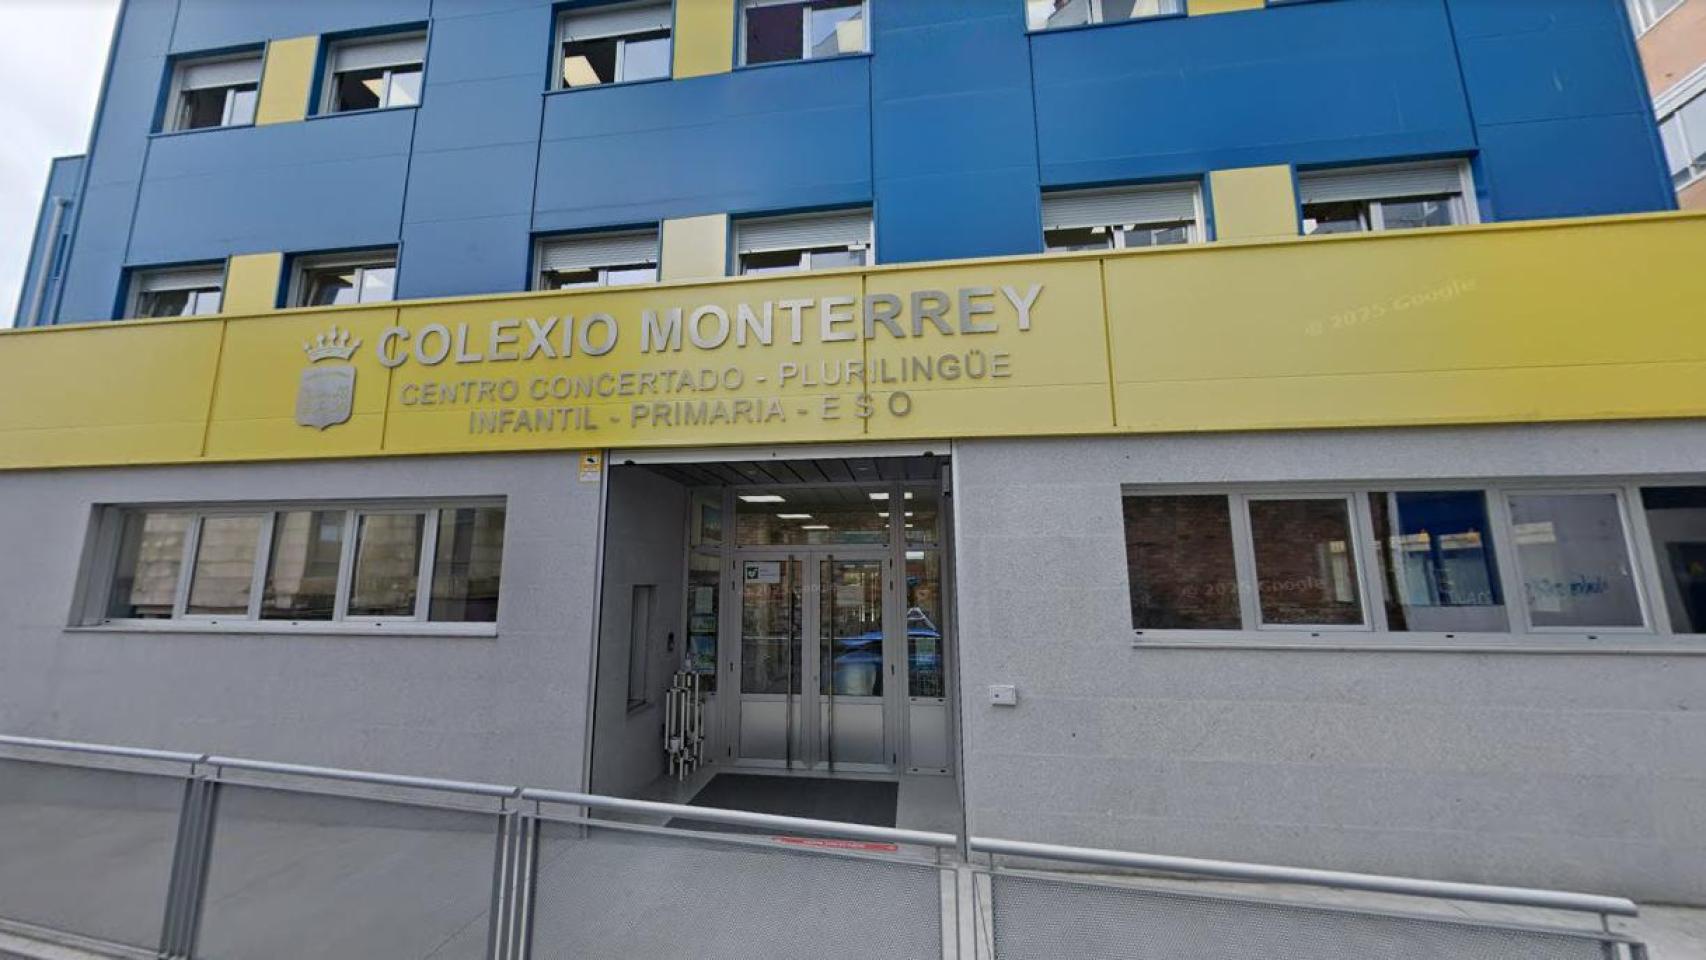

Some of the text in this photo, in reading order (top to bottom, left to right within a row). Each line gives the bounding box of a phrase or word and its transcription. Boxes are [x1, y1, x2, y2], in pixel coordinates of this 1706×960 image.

[376, 283, 1044, 368] COLEXIO MONTERREY
[400, 377, 519, 406] CENTRO
[530, 366, 744, 401] CONCERTADO
[779, 350, 1013, 387] PLURILINGÜE
[470, 407, 598, 435] INFANTIL
[630, 396, 786, 430] PRIMARIA
